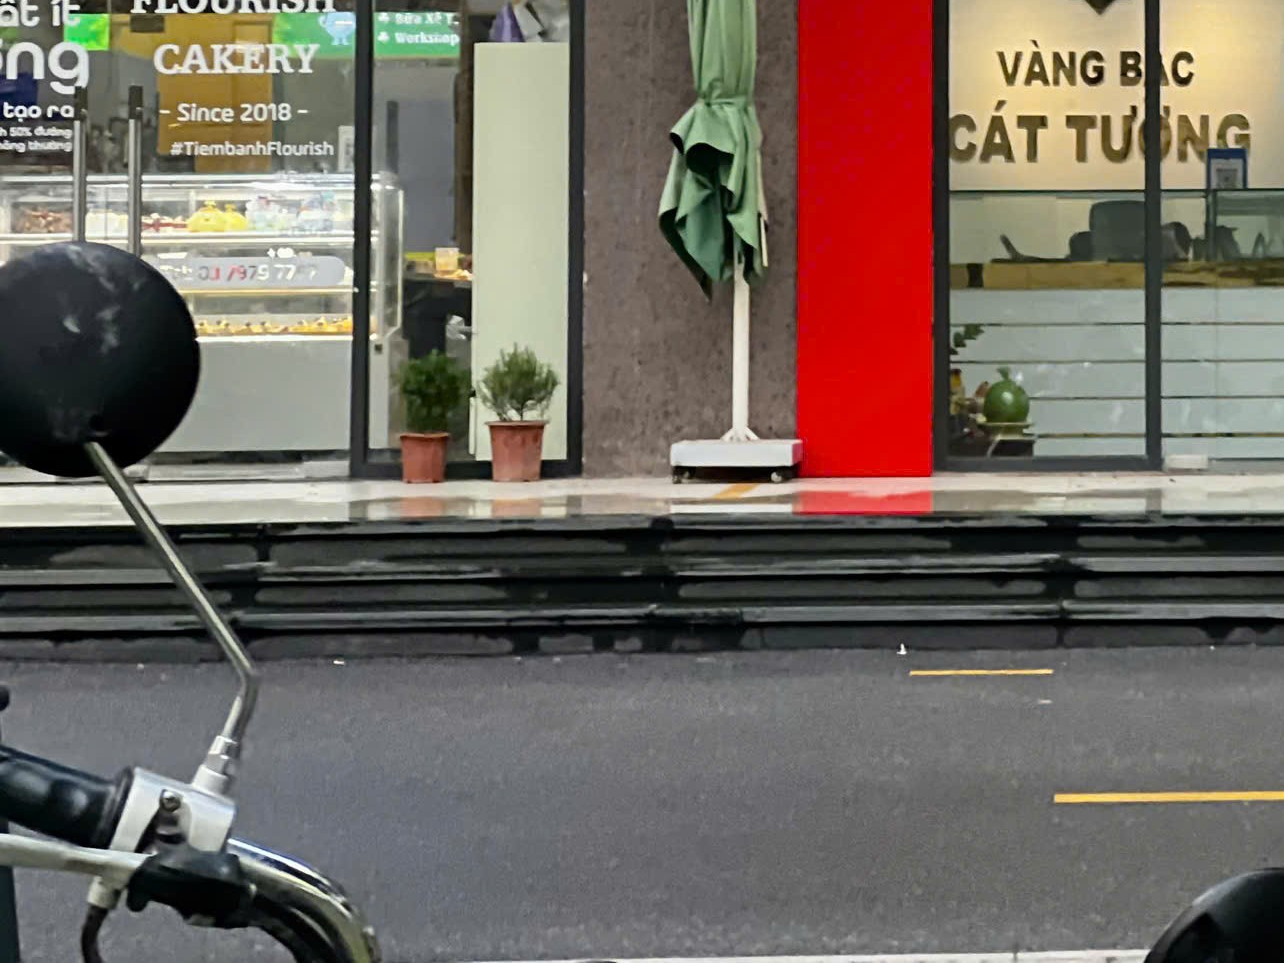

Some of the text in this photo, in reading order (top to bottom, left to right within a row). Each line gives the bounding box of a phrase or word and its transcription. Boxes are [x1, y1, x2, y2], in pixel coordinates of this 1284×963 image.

[0, 40, 90, 95] ng
[153, 43, 320, 74] CAKERY
[997, 40, 1105, 86] VÀNG
[3, 102, 74, 122] tạo ra
[177, 103, 234, 122] Since
[240, 103, 292, 122] 2018
[949, 100, 1049, 163] CÁT
[171, 141, 334, 156] #TiembanhFlourish
